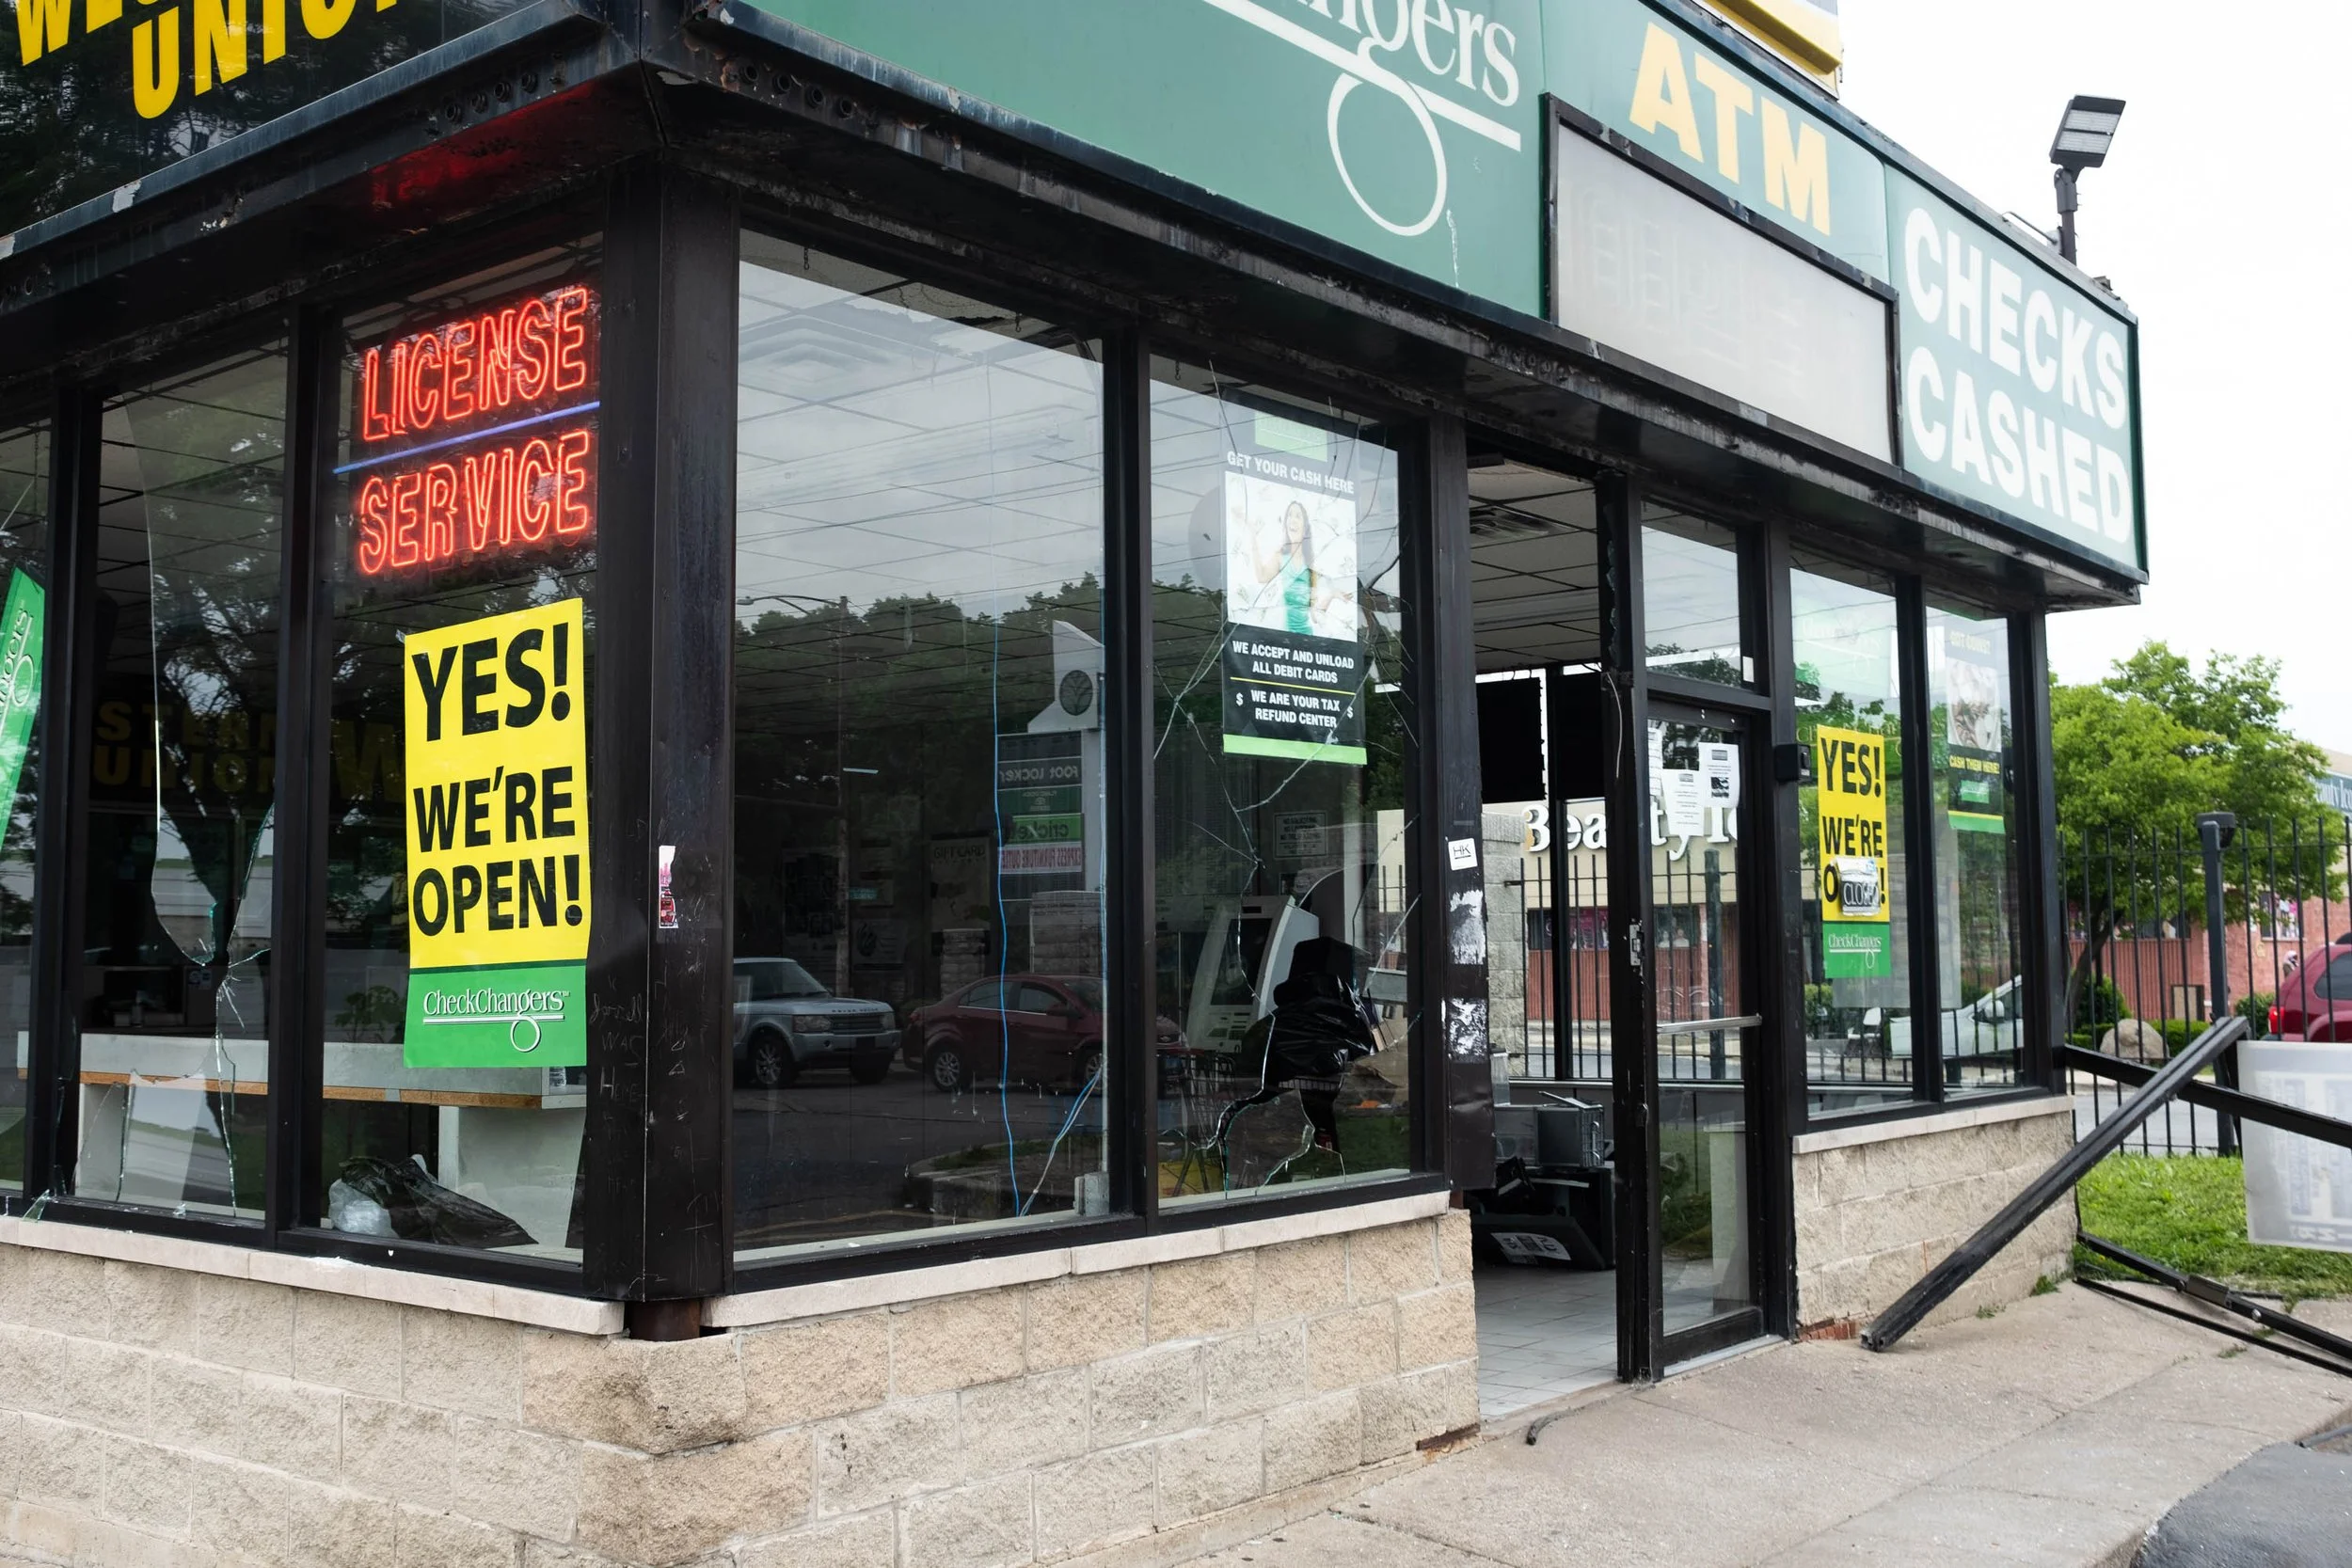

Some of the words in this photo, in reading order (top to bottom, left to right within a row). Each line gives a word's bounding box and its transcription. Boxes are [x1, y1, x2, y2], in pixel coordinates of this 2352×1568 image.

[133, 0, 397, 119] UNI
[1629, 22, 1831, 235] ATM
[1905, 207, 2126, 430] CHECKS
[363, 288, 589, 442] LICENSE
[1227, 450, 1251, 469] GET
[1254, 456, 1289, 480] YOUR
[1290, 466, 1322, 487] CASH
[1325, 474, 1355, 494] HERE
[1905, 346, 2132, 545] CASHED
[358, 430, 590, 576] SERVICE
[411, 622, 570, 743] YES!
[1232, 641, 1249, 656] WE
[1251, 643, 1291, 662] ACCEPT
[1293, 649, 1314, 665] AND
[1314, 652, 1355, 670] UNLOAD
[1252, 660, 1272, 675] ALL
[1274, 662, 1305, 680] DEBIT
[1305, 665, 1338, 684] CARDS
[1250, 689, 1267, 705] WE
[1267, 691, 1290, 706] ARE
[1291, 693, 1320, 710] YOUR
[1321, 696, 1341, 713] TAX
[1255, 706, 1297, 725] REFUND
[1298, 711, 1338, 728] CENTER
[413, 766, 576, 852] WE'RE
[1821, 736, 1882, 798] YES!
[1822, 814, 1883, 859] WE'RE
[411, 854, 582, 938] OPEN!
[422, 988, 570, 1053] CheckChangers
